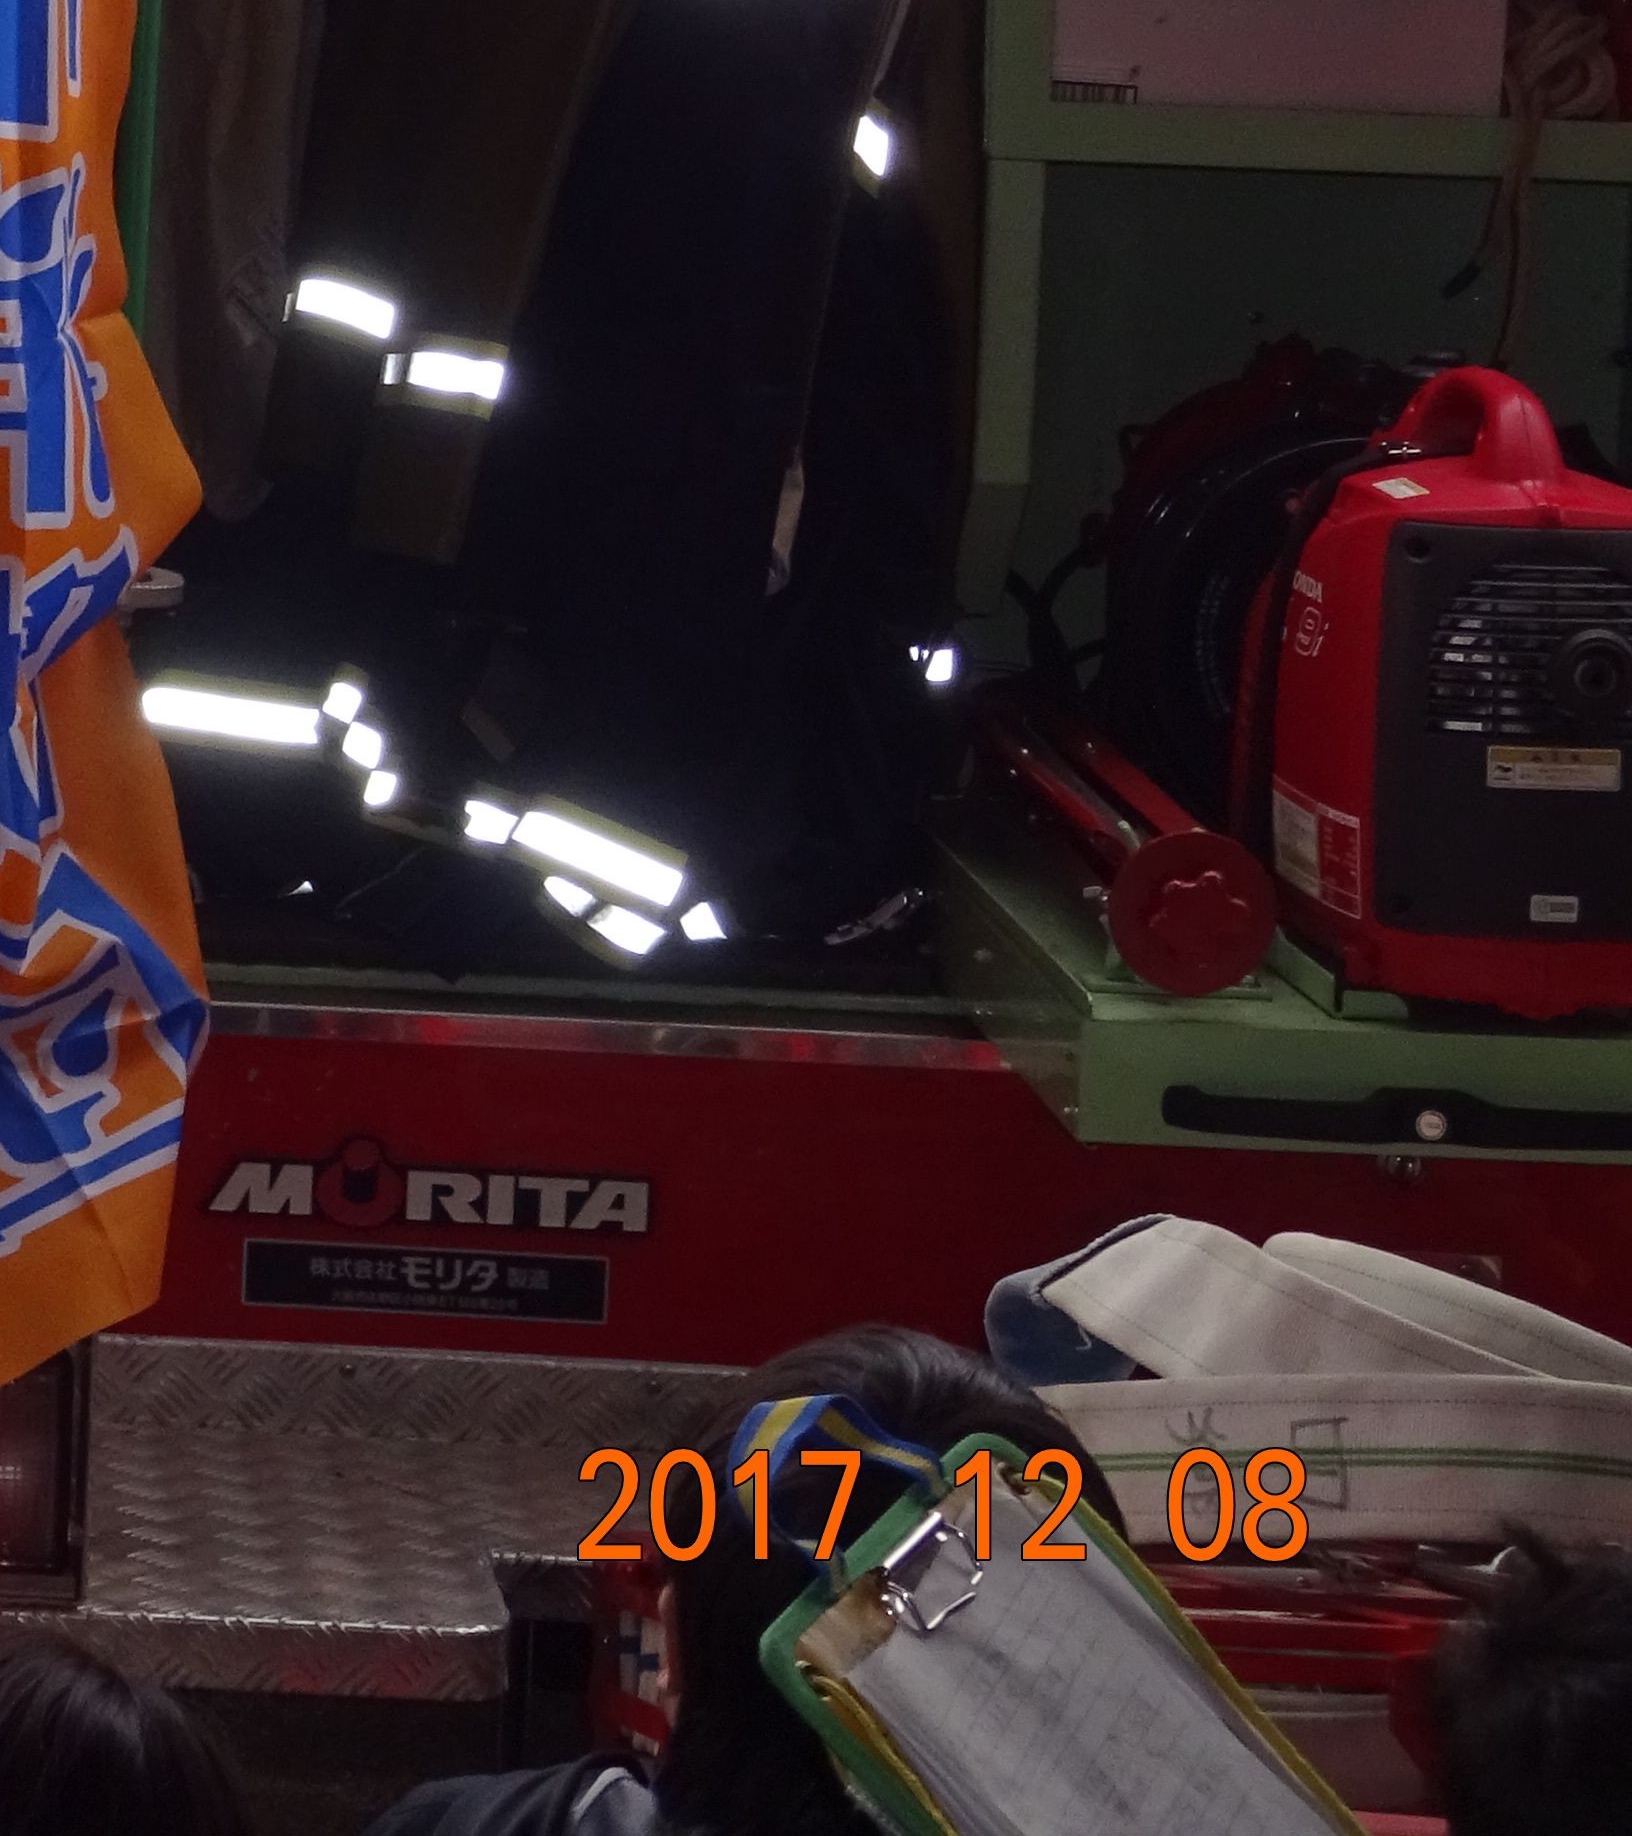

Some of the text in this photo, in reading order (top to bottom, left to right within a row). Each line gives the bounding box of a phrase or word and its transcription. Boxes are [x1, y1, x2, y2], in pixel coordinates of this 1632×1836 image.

[209, 1137, 649, 1233] MORITA
[309, 1256, 499, 1292] 株式会社モリタ
